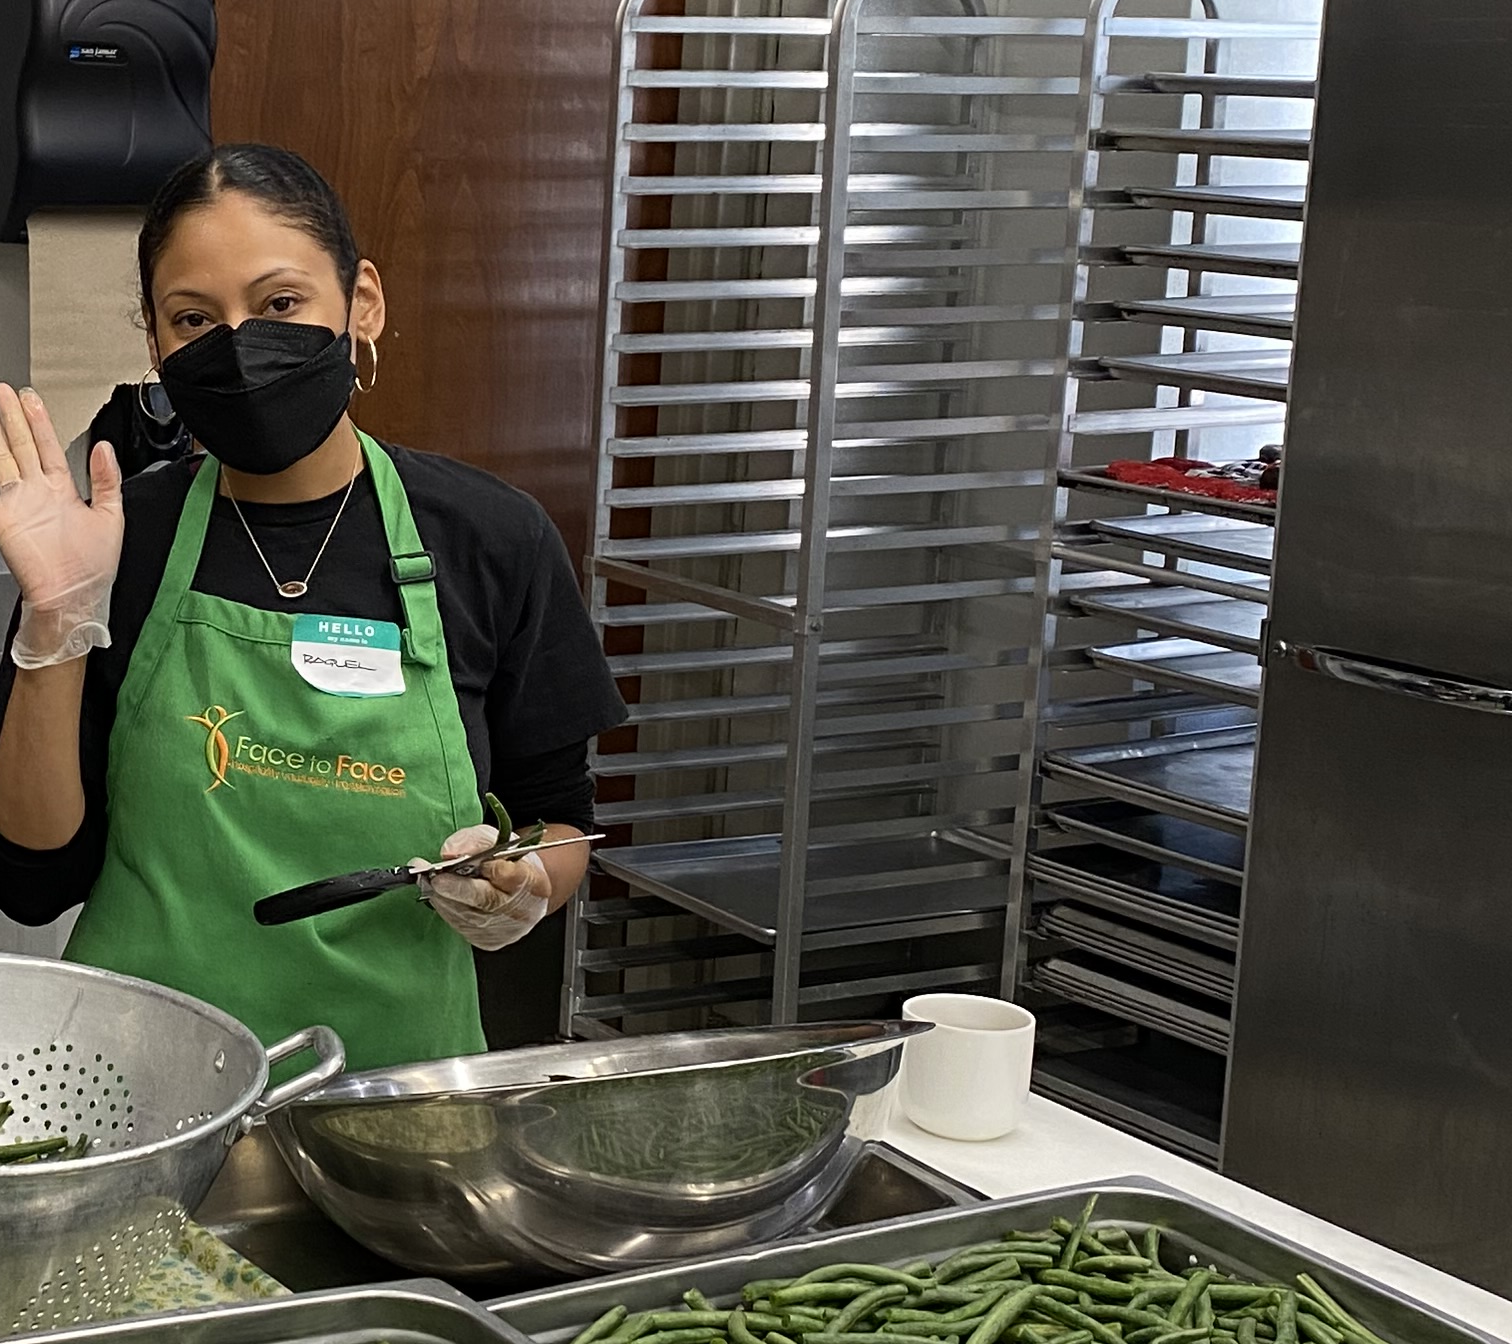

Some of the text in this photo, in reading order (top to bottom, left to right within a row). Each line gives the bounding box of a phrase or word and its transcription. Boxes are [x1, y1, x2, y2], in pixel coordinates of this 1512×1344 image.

[319, 621, 375, 637] HELLO
[235, 736, 305, 770] Face
[309, 755, 332, 774] to
[336, 754, 406, 785] Face
